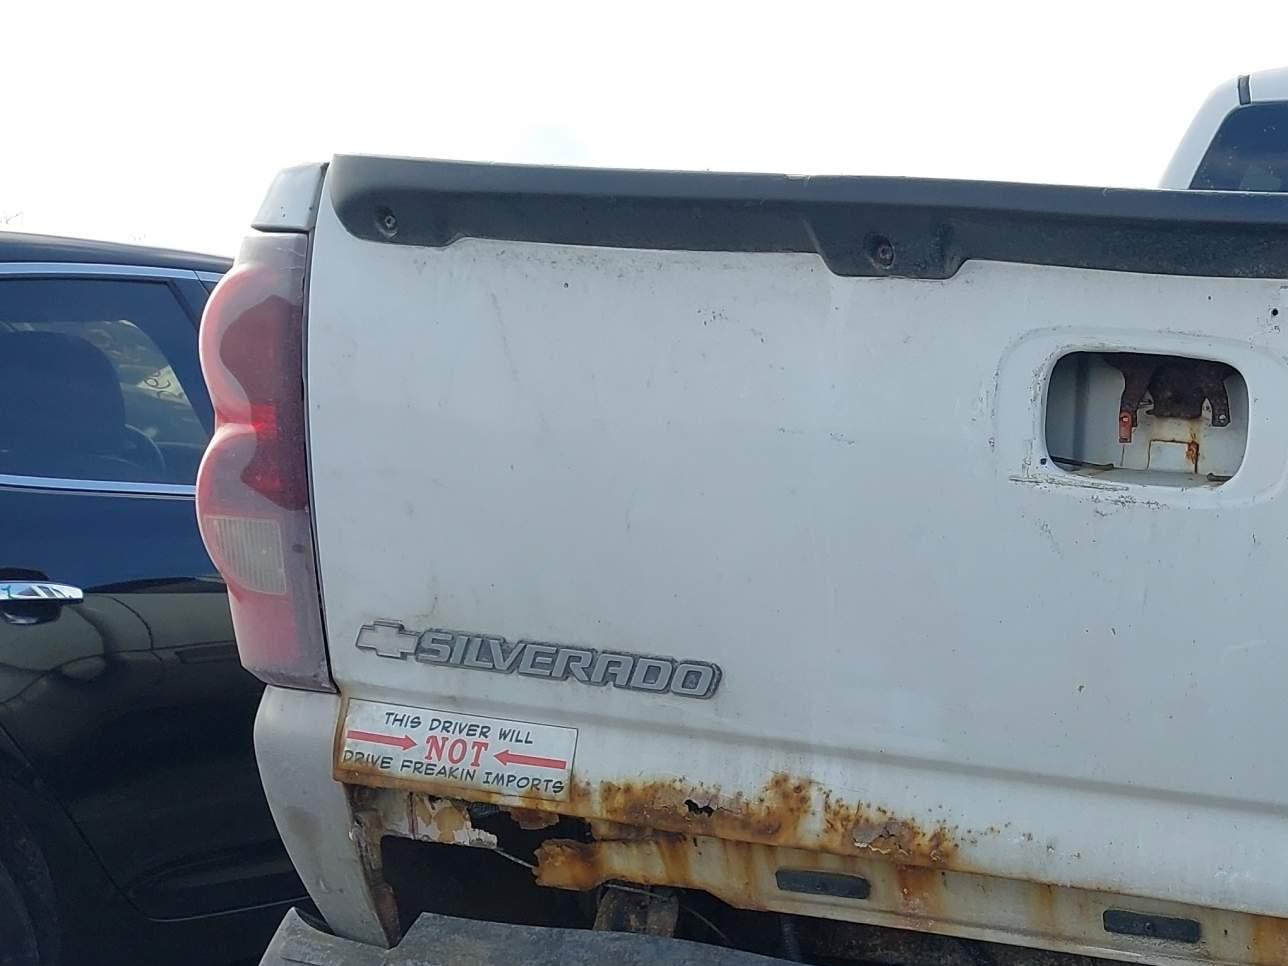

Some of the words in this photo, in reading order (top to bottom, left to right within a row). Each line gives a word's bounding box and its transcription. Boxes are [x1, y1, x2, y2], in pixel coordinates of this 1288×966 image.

[416, 628, 723, 699] SILVERADO
[384, 712, 422, 729] THIS
[428, 718, 492, 739] DRIVER
[498, 728, 534, 745] WILL
[424, 735, 489, 768] NOT
[342, 749, 394, 770] DRIVE
[399, 759, 477, 782] FREAKIN
[482, 771, 565, 794] IMPORTS
